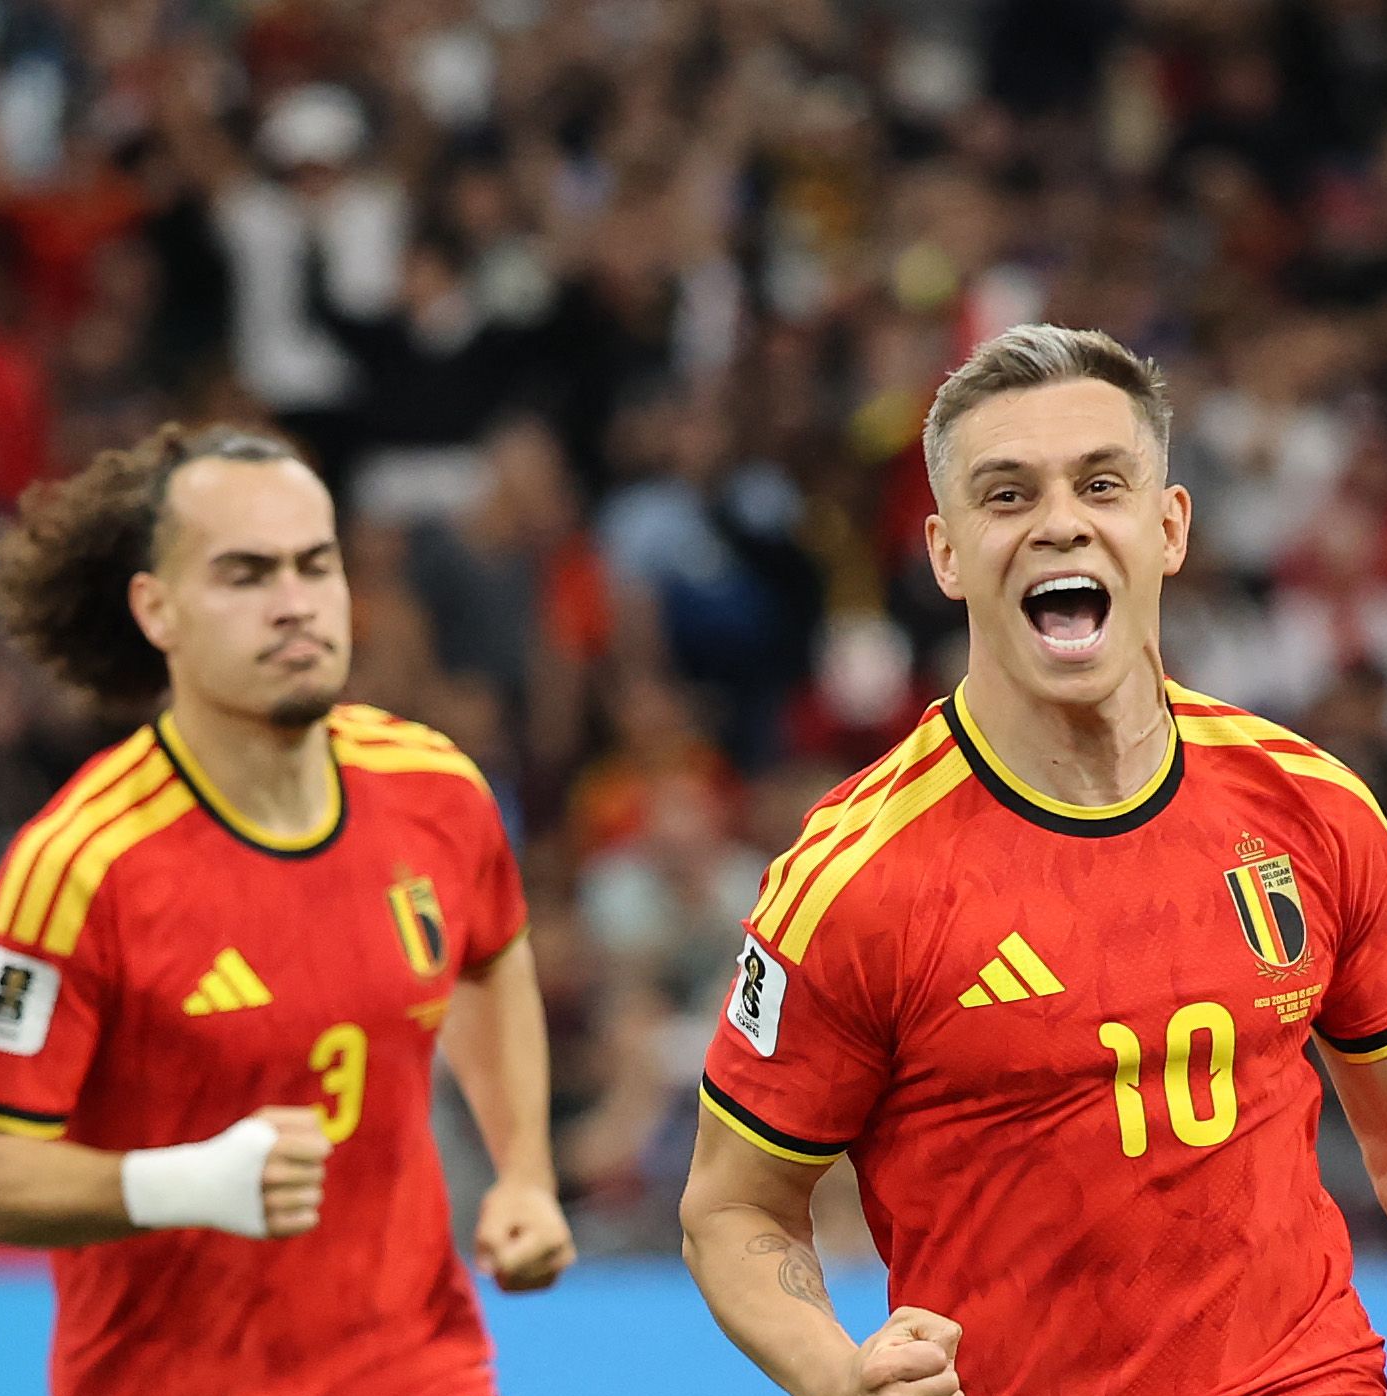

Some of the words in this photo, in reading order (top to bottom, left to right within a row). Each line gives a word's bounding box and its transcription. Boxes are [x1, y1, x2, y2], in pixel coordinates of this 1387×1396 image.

[1258, 861, 1281, 872] ROYAL
[1261, 867, 1291, 881] BELGIAN
[308, 1022, 368, 1145] 3
[1098, 1001, 1238, 1158] 10
